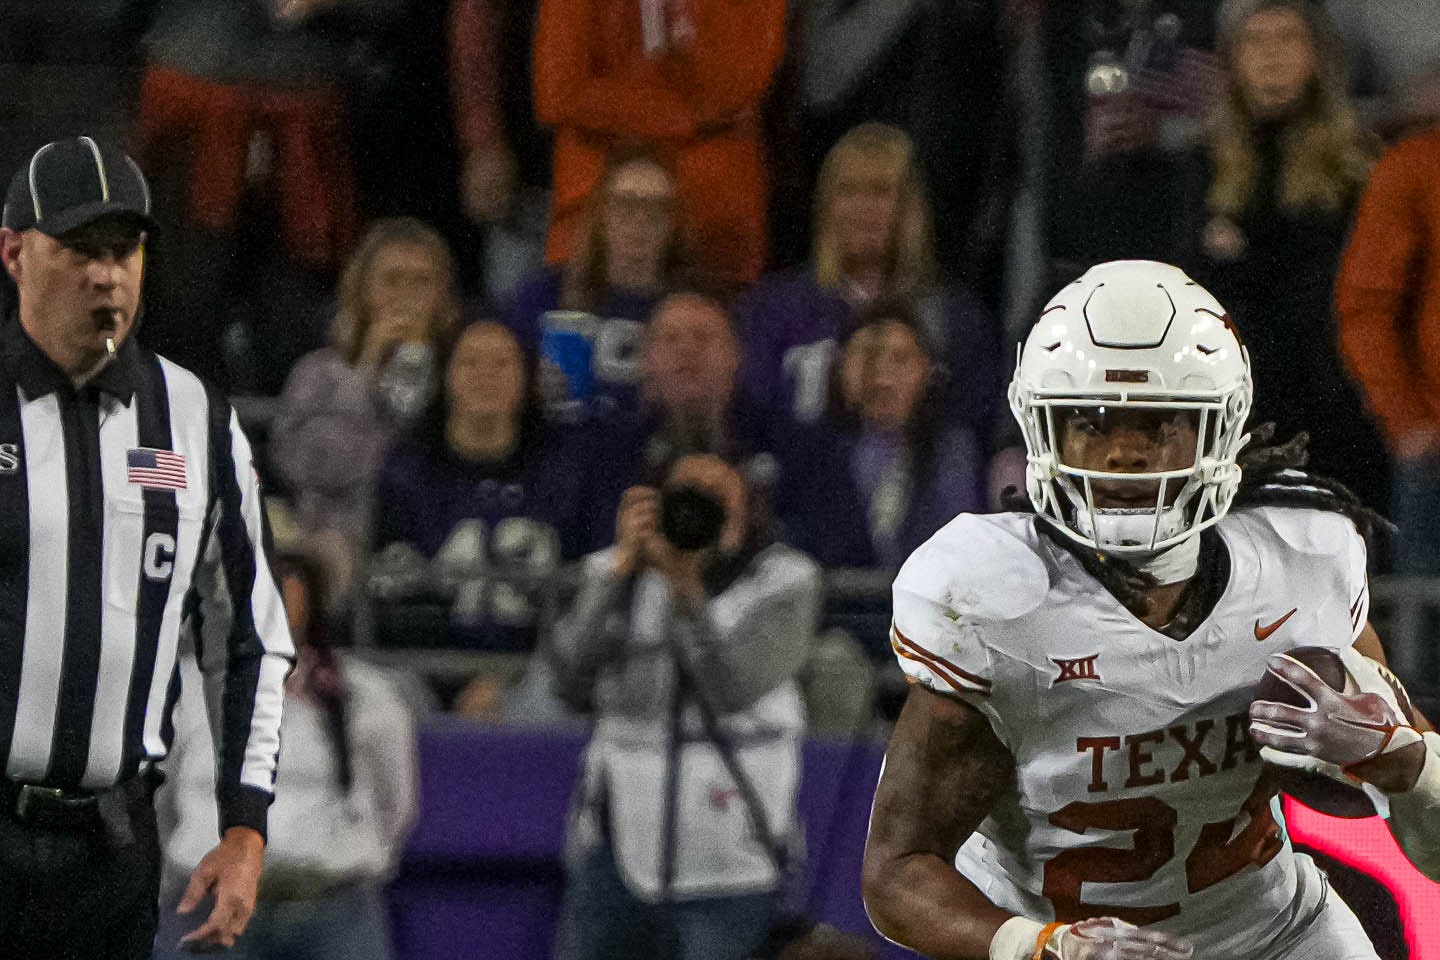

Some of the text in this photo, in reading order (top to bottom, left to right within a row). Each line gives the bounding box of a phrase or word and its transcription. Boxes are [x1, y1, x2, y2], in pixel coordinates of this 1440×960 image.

[144, 532, 175, 579] C
[1052, 655, 1100, 684] XII
[1077, 712, 1261, 793] TEXA
[1042, 772, 1284, 926] 24
